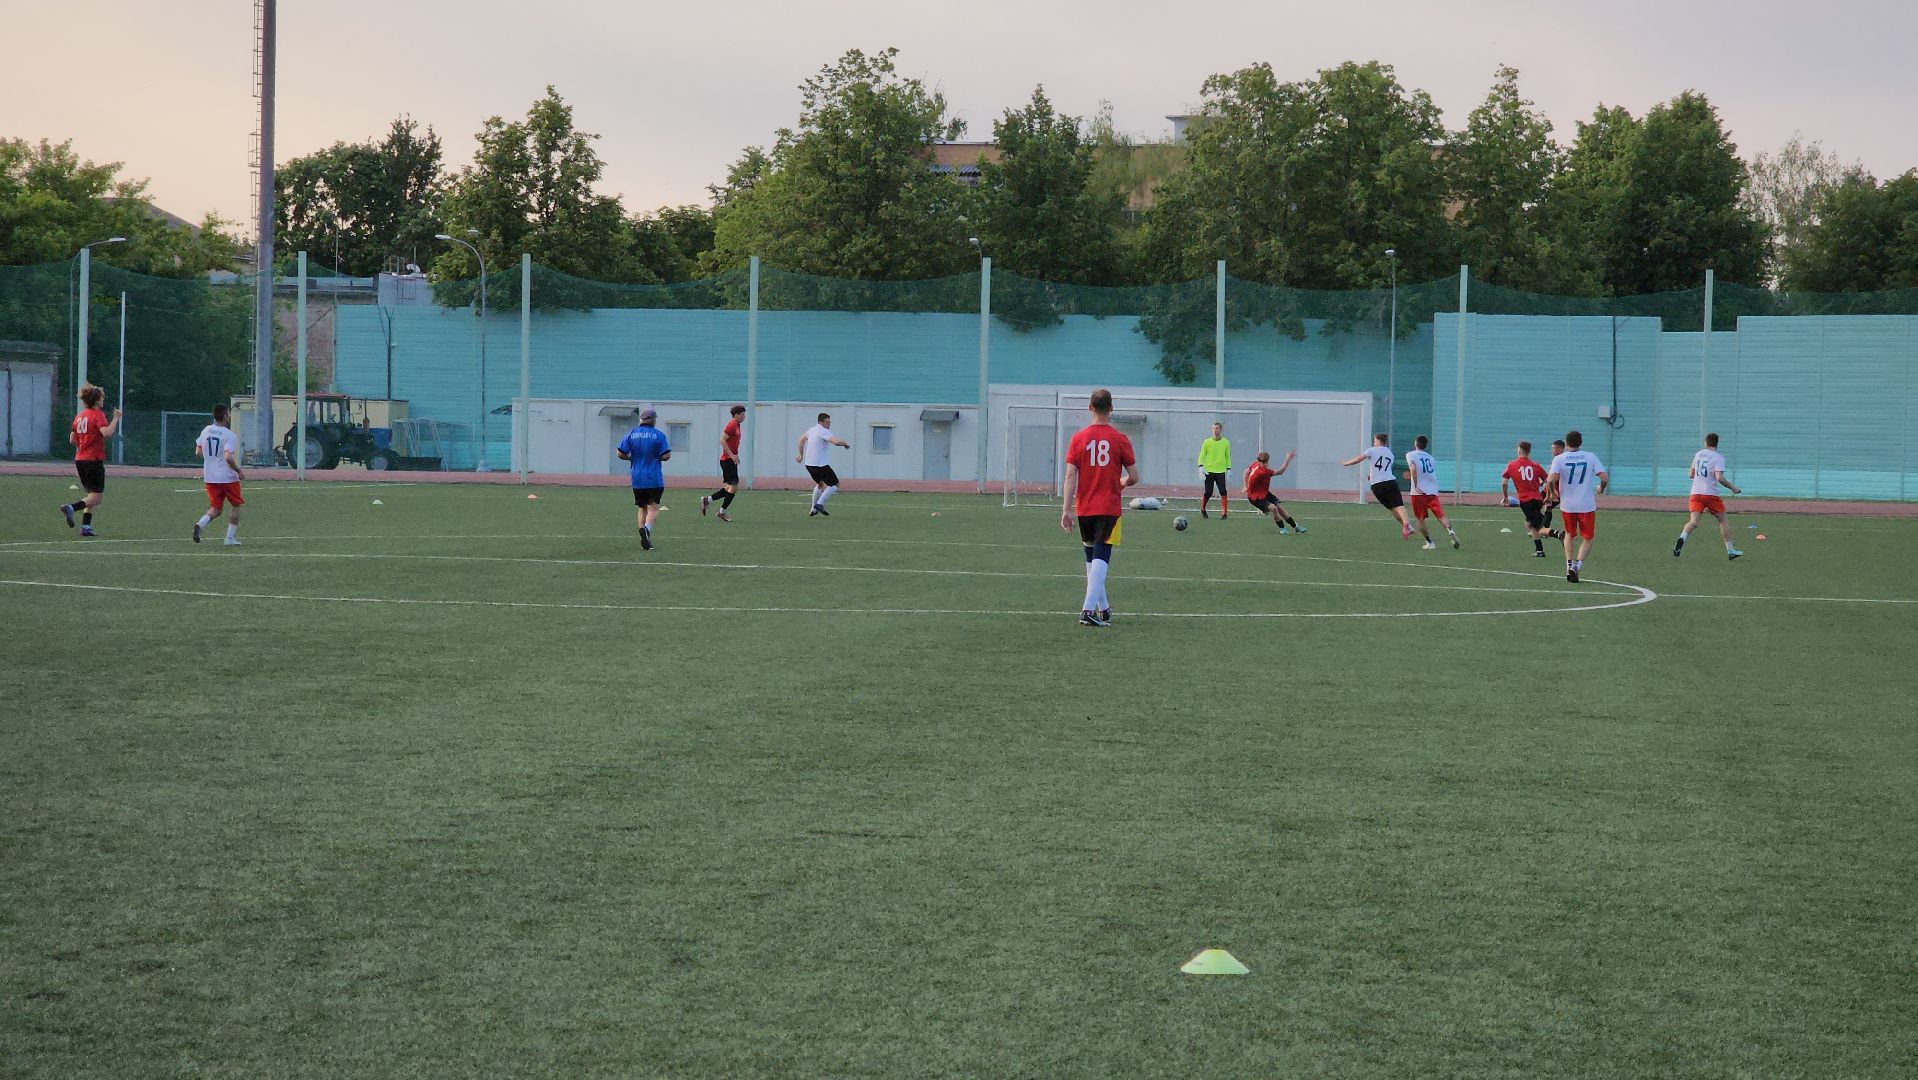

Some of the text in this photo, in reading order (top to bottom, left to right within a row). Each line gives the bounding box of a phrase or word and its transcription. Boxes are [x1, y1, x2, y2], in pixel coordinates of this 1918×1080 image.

[206, 436, 220, 457] 17
[1085, 439, 1110, 467] 18
[1374, 455, 1392, 471] 47
[1518, 465, 1534, 481] 10
[1565, 462, 1588, 485] 77
